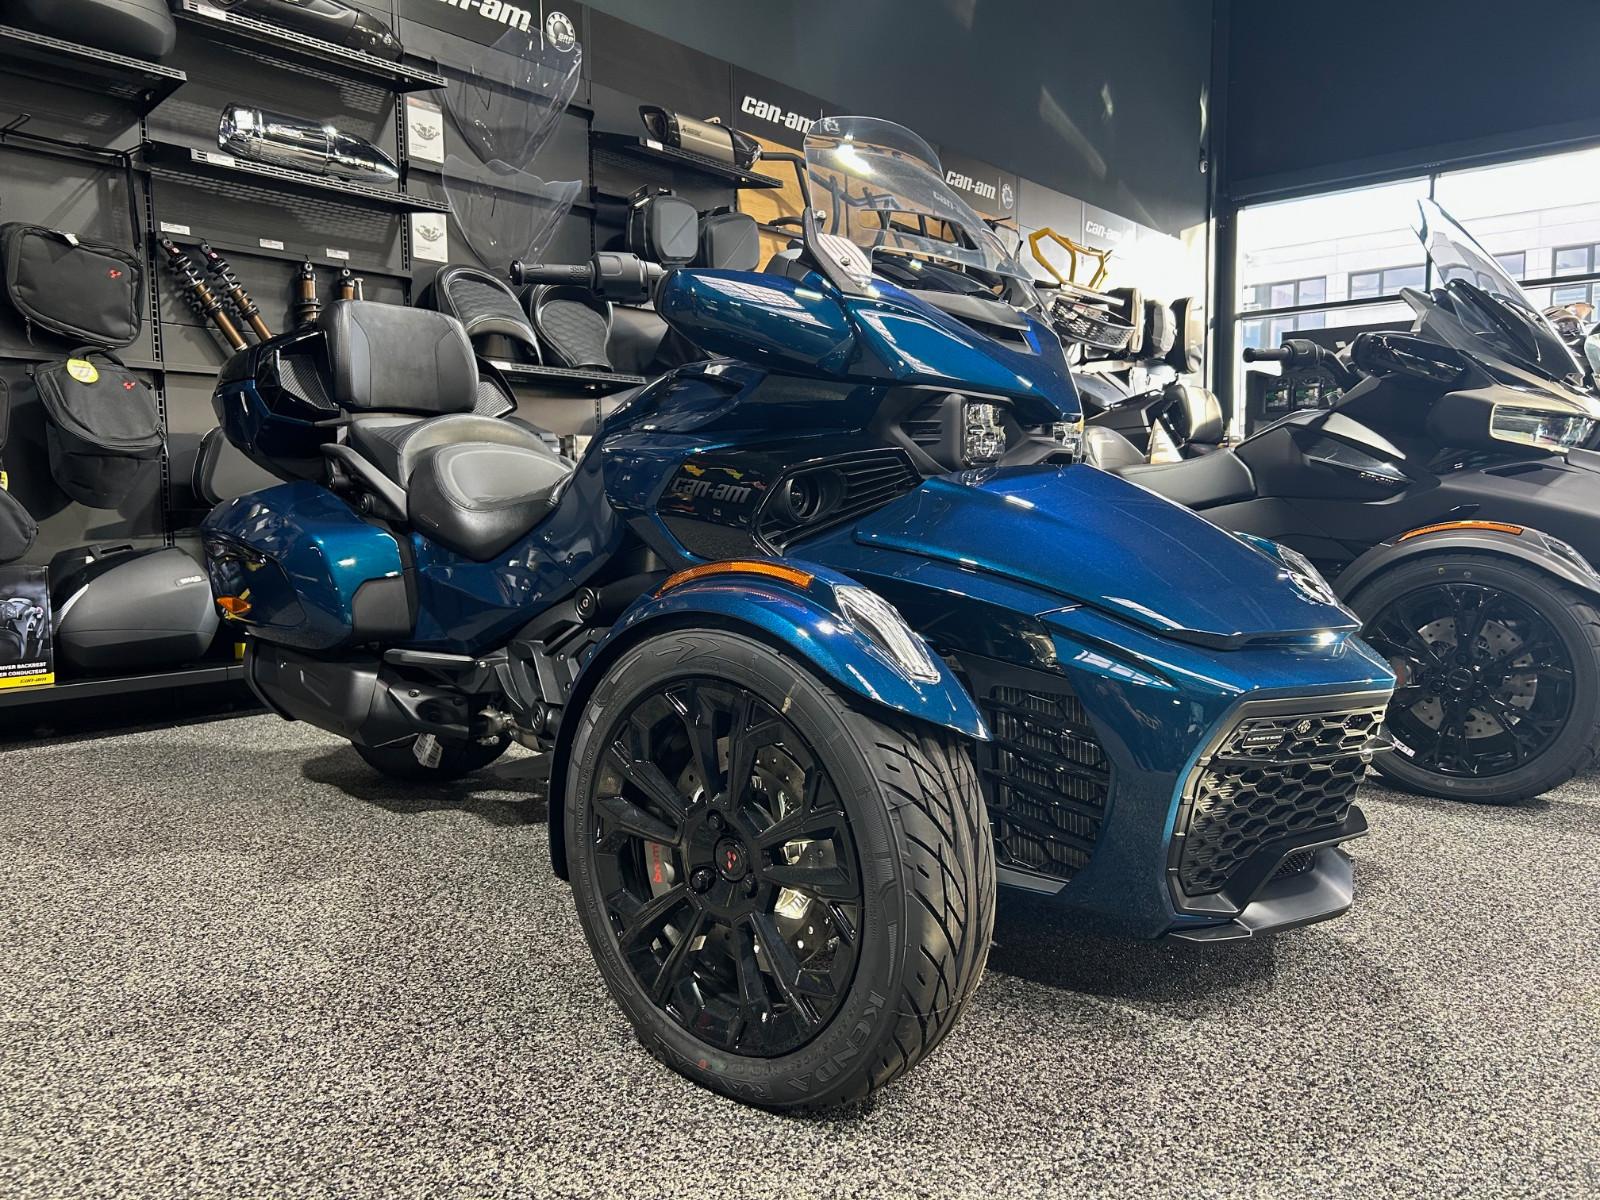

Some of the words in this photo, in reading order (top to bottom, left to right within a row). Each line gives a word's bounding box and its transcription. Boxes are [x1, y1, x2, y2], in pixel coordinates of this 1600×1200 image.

[741, 95, 816, 134] can-am
[945, 170, 997, 200] can-am
[1085, 220, 1119, 240] can-a
[671, 477, 752, 504] can-am
[786, 989, 887, 1093] KENDA
